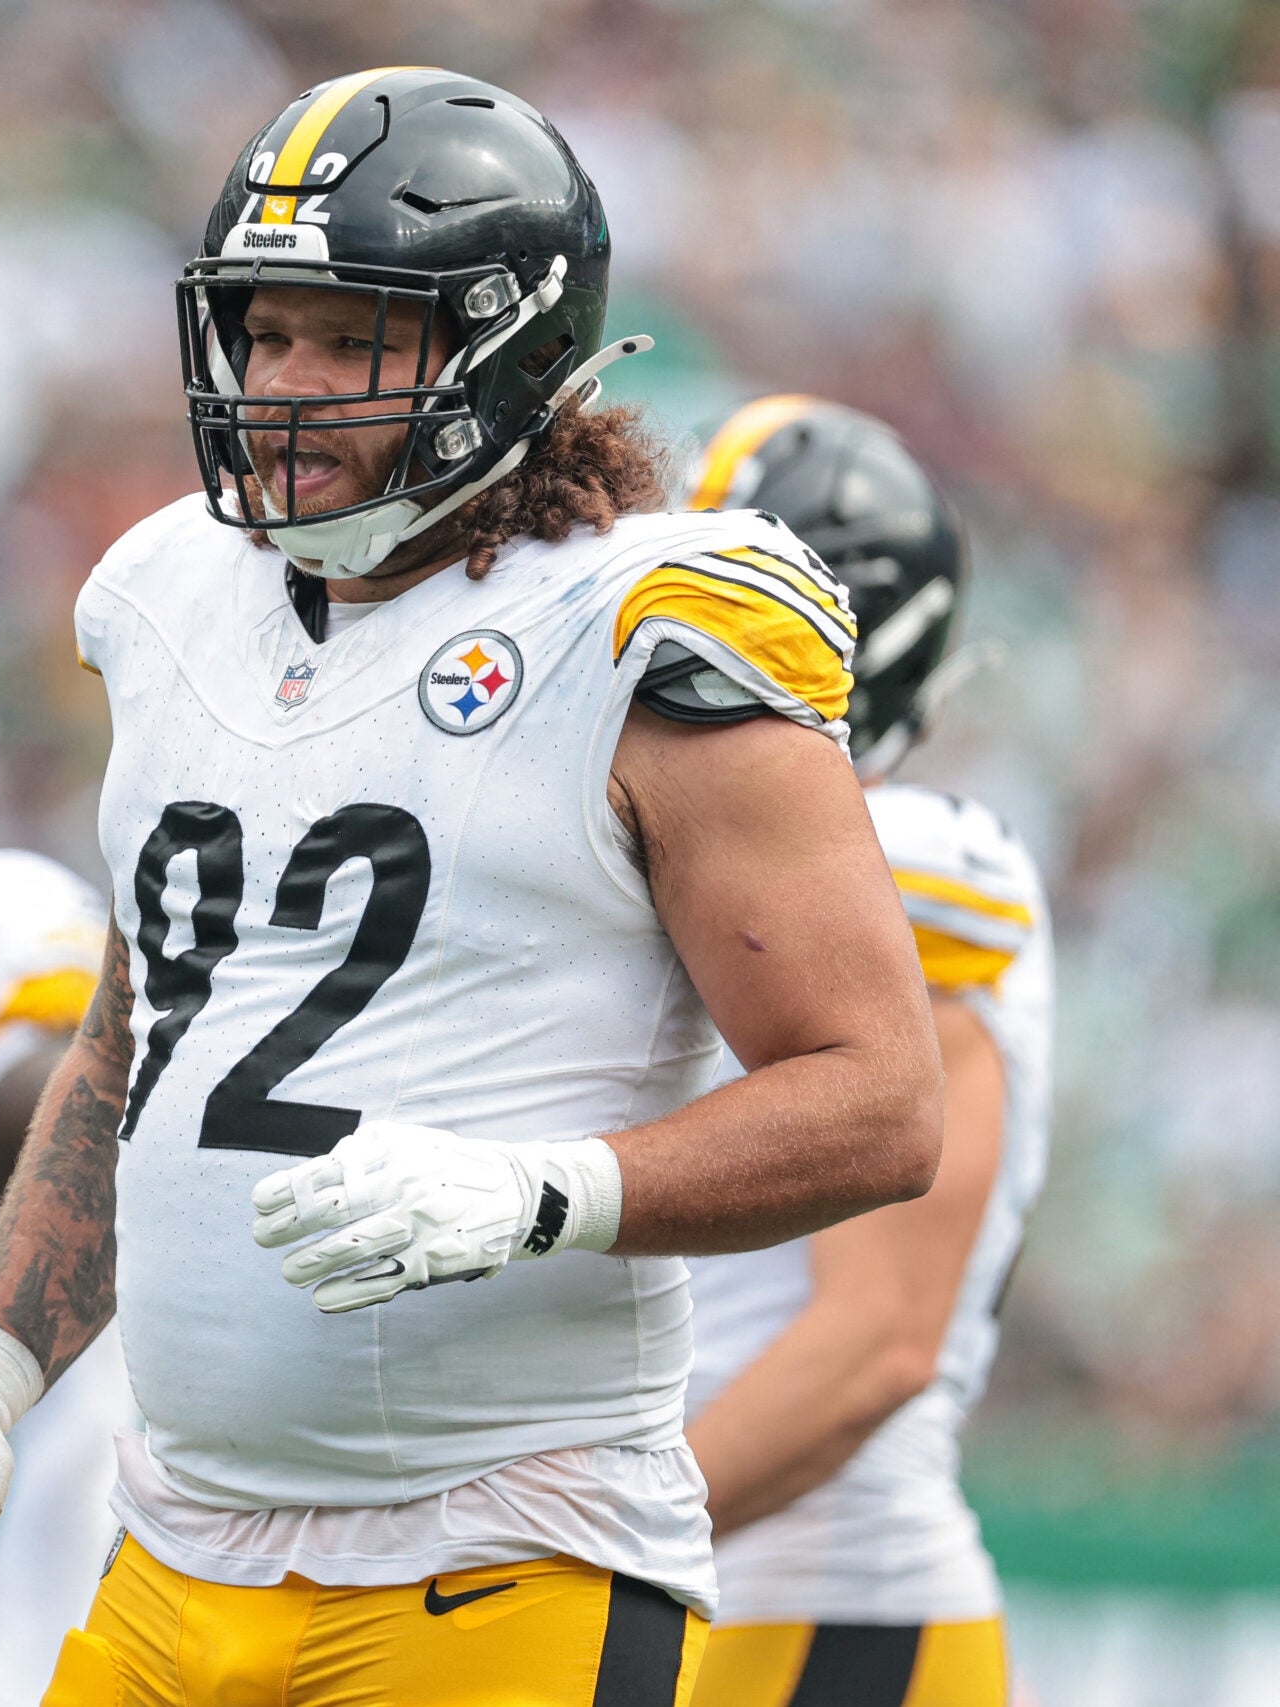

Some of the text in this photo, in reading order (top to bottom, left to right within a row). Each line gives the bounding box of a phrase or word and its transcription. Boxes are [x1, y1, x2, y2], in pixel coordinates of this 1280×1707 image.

[237, 150, 349, 225] 92
[243, 228, 297, 249] Steelers
[278, 680, 306, 700] NFL
[430, 671, 471, 686] Steelers
[117, 800, 432, 1158] 92
[523, 1180, 569, 1256] NIKE
